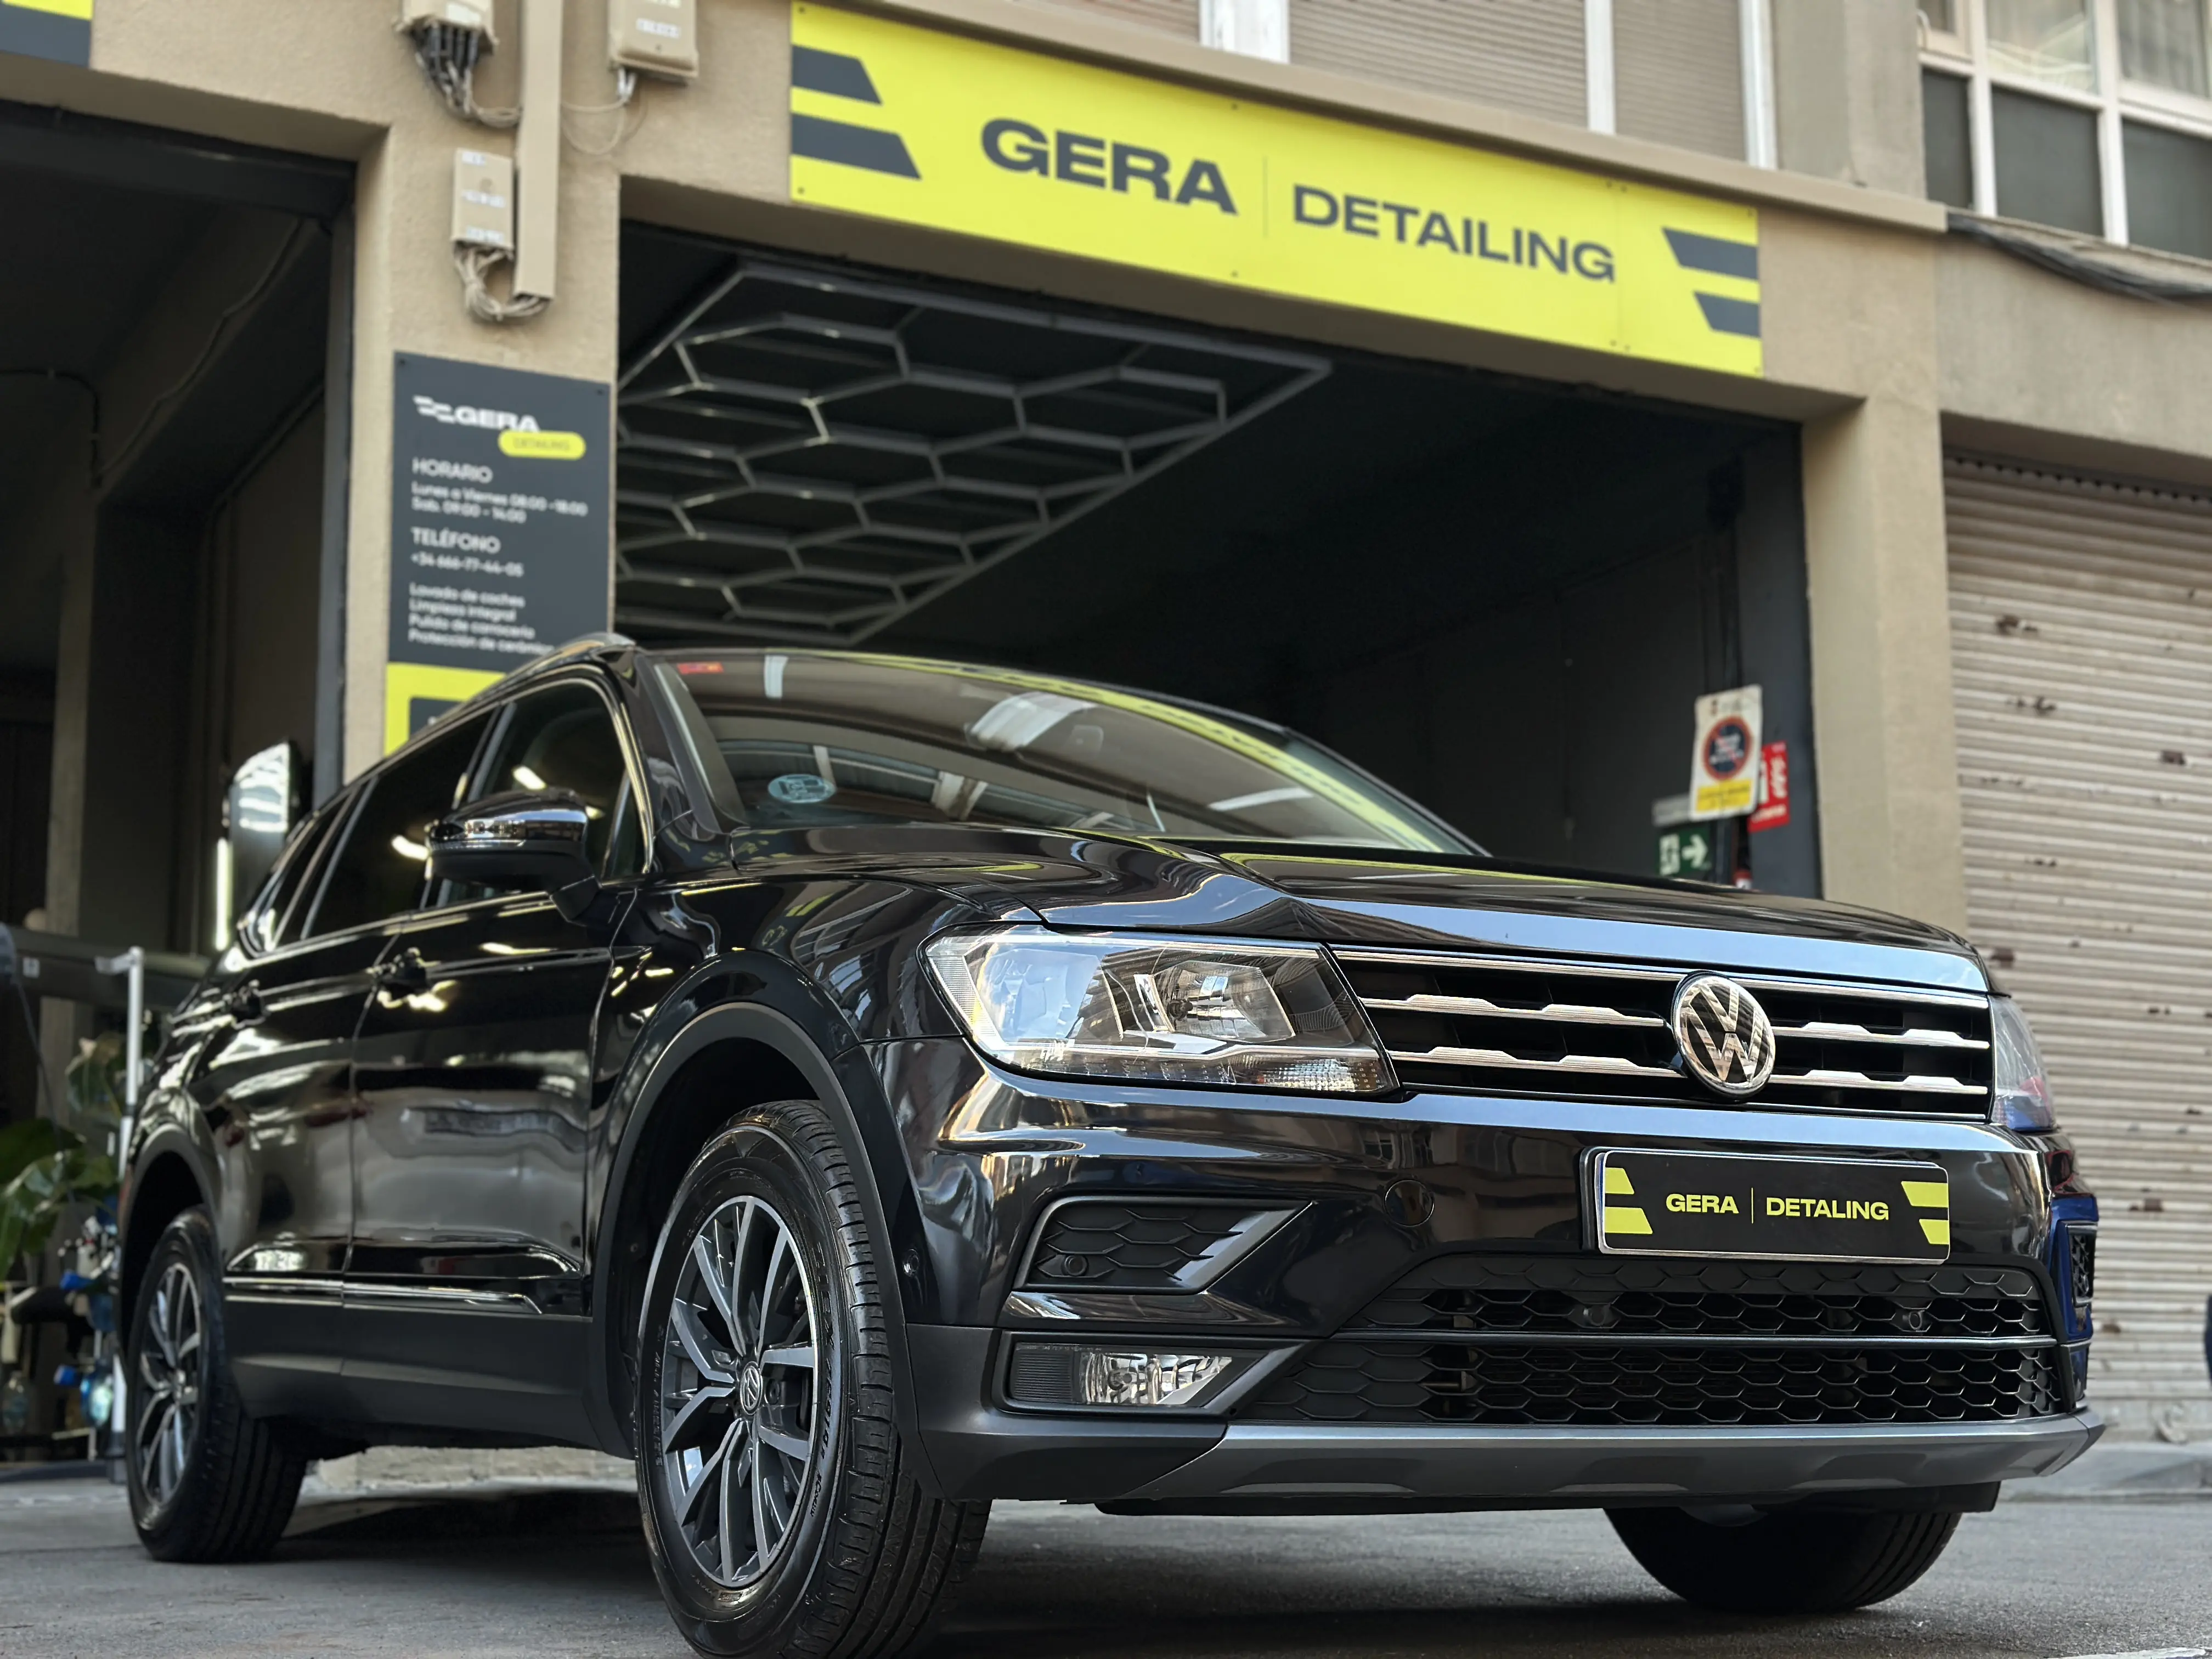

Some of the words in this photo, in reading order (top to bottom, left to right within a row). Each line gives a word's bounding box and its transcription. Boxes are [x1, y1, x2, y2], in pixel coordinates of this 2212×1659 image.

[981, 118, 1238, 215] GERA
[1293, 183, 1616, 282] DETAILING
[454, 405, 540, 432] GERA
[412, 458, 493, 483] HORARIO
[411, 481, 449, 499] Lunes
[450, 487, 462, 499] a
[462, 487, 509, 506] Viernes
[410, 526, 501, 554] TELÉFONO
[409, 582, 459, 600] Lavado
[460, 588, 478, 602] de
[478, 591, 526, 608] coches
[408, 597, 466, 617] Limpieza
[467, 603, 517, 622] integral
[408, 612, 450, 630] Pulido
[450, 618, 470, 631] de
[478, 636, 495, 650] de
[1666, 1194, 1739, 1214] GERA
[1767, 1198, 1889, 1220] DETALING
